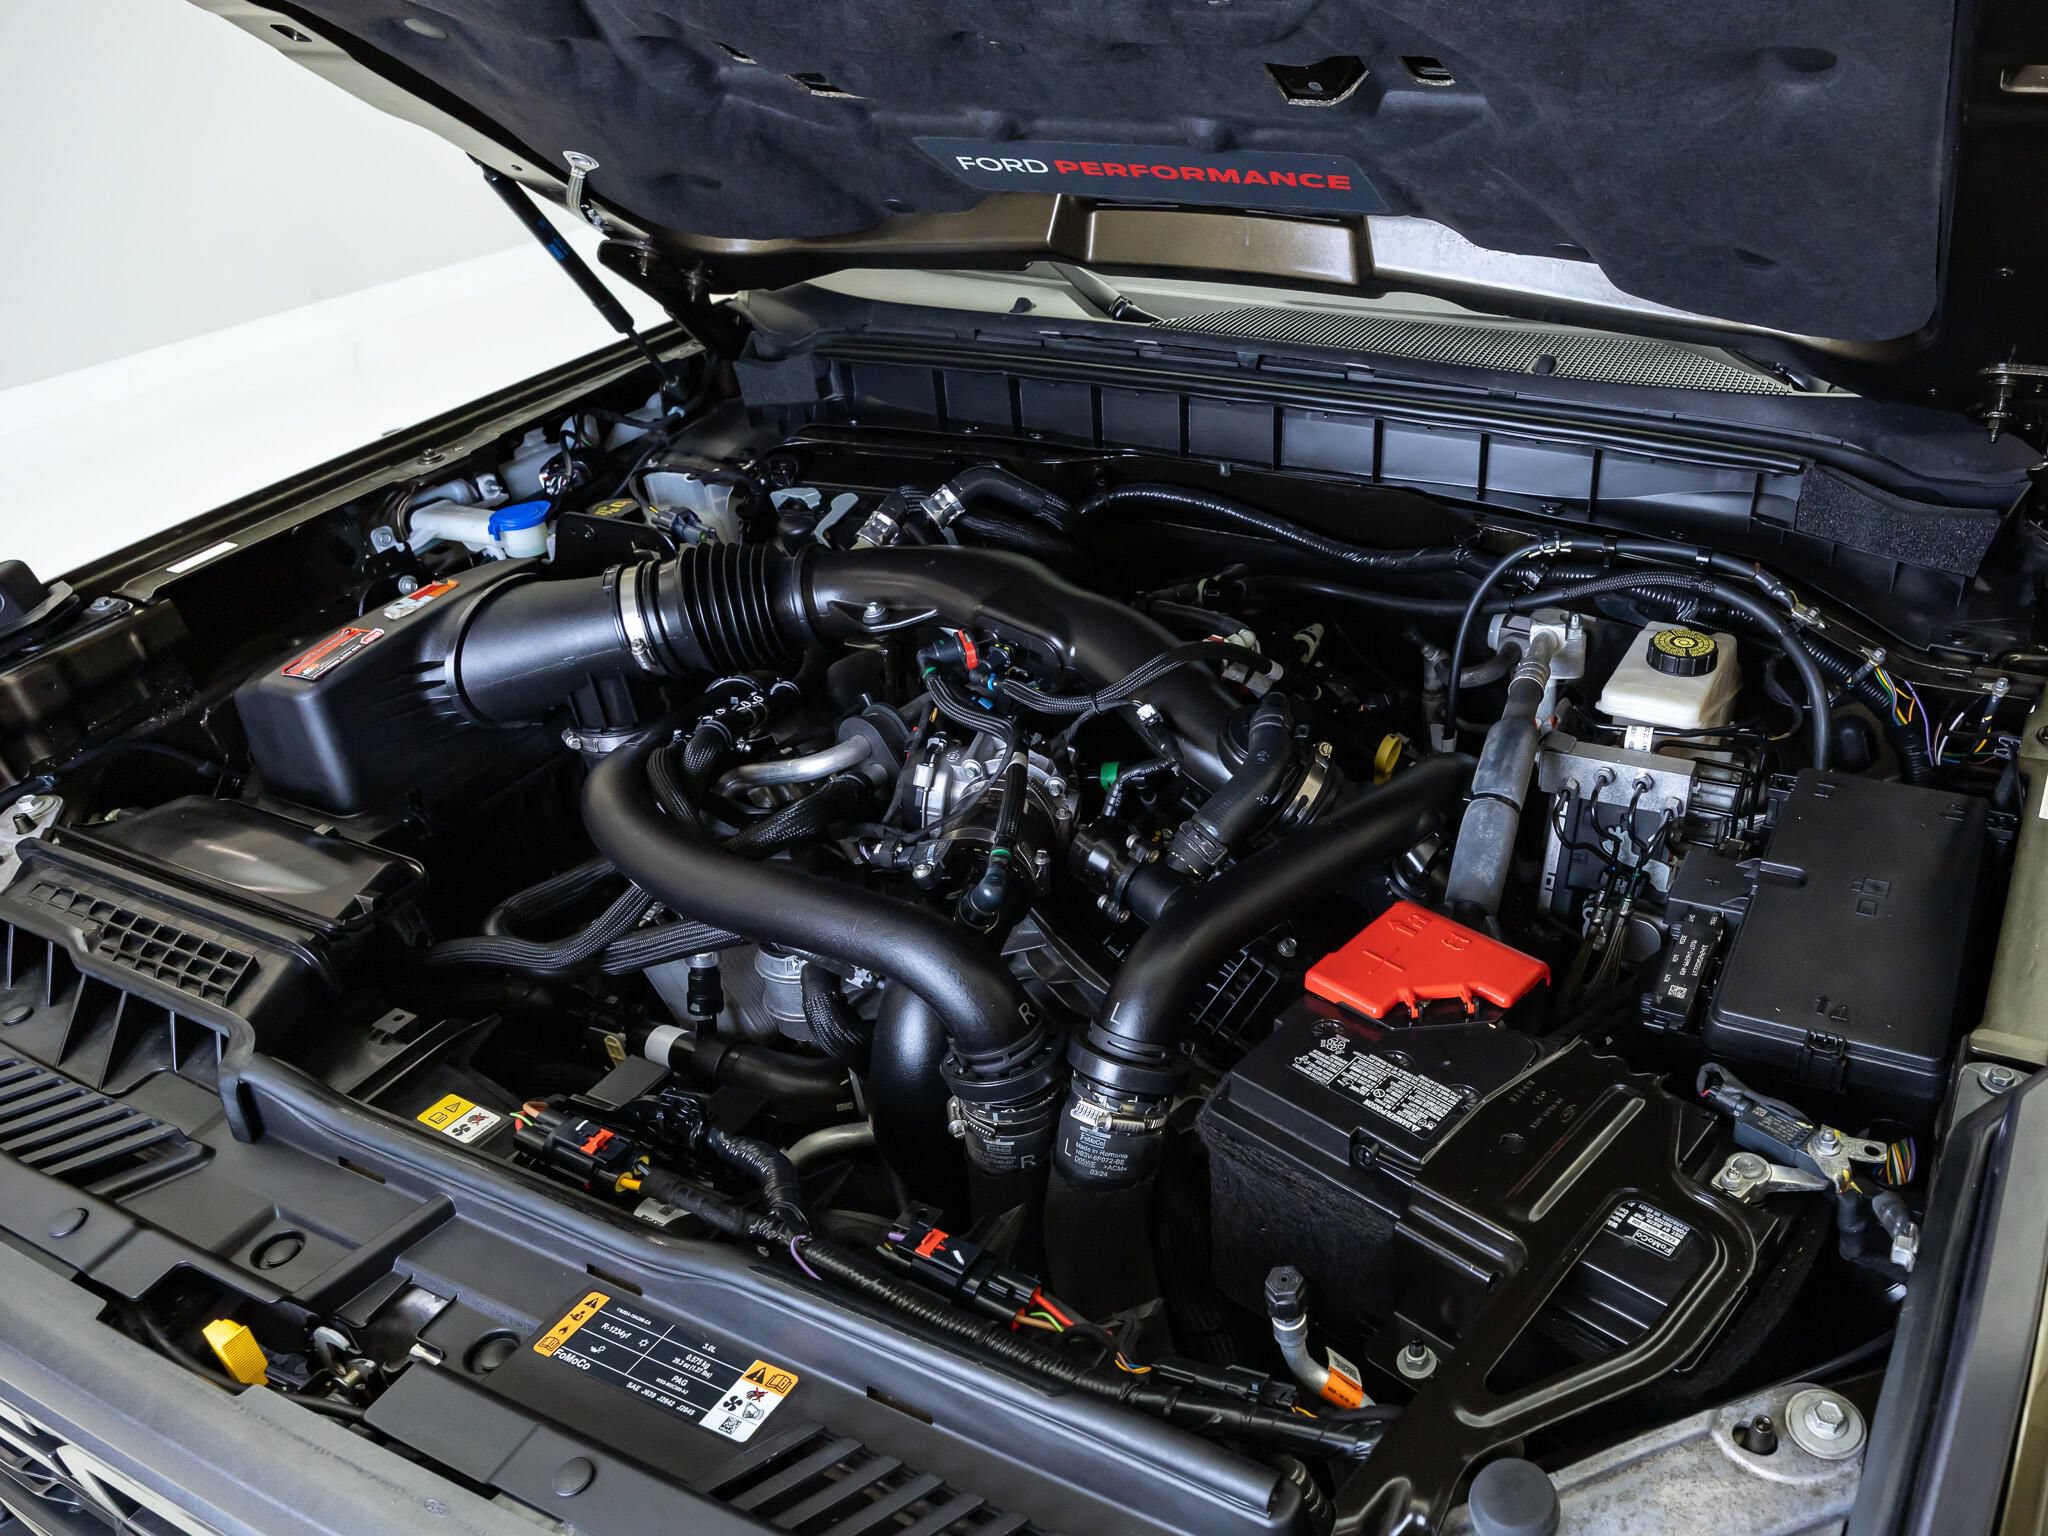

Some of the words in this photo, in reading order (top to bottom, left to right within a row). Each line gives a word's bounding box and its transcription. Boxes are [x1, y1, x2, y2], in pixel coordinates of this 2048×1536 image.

[956, 155, 1049, 174] FORD
[1053, 159, 1351, 191] PERFORMANCE
[1018, 1002, 1035, 1024] R
[1110, 1001, 1120, 1025] L
[1361, 1098, 1413, 1128] DANGER/POISON
[1065, 1138, 1071, 1157] L
[1021, 1154, 1036, 1169] R
[1636, 1232, 1673, 1253] FoMoCo
[599, 1322, 631, 1339] R-1234yf
[701, 1342, 718, 1353] 3.0L
[552, 1348, 593, 1370] FoMoCo
[684, 1353, 704, 1365] 0.575
[699, 1360, 712, 1370] kg
[625, 1381, 641, 1391] SAE
[670, 1375, 689, 1386] PAG
